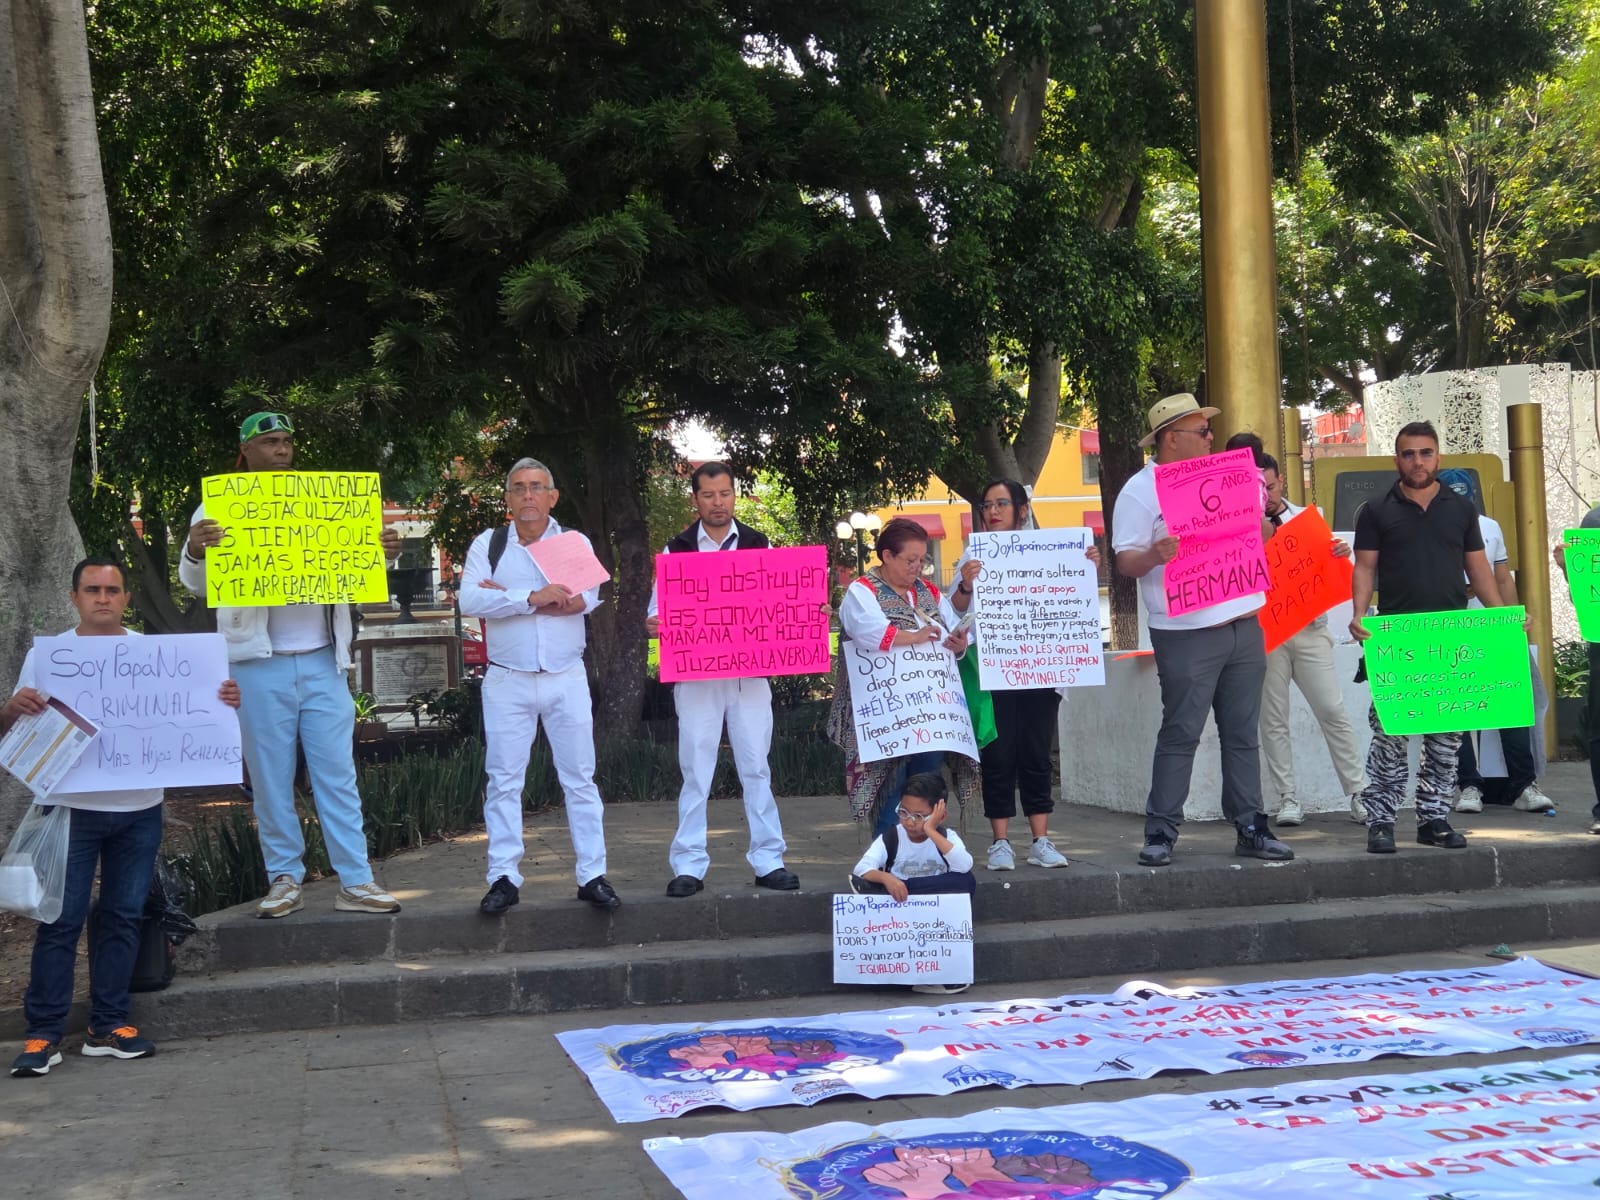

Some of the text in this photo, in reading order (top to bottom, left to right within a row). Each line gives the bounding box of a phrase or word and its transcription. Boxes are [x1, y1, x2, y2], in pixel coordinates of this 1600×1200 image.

[207, 474, 381, 498] CADA CONVIVENCIA
[1199, 479, 1221, 512] 6
[243, 526, 331, 548] TIEMPO
[336, 526, 377, 546] QUE
[215, 550, 382, 573] JAMÁS REGRESA
[976, 560, 1085, 584] Soy mamá soltera
[1213, 558, 1221, 566] a
[211, 571, 368, 602] Y TE ARREBATAN PARA
[664, 557, 825, 602] Hoy obstruyen
[1166, 557, 1271, 613] HERMANA
[286, 592, 356, 605] SIEMPRE
[977, 585, 1004, 599] pero
[1007, 586, 1027, 594] aun
[1048, 586, 1077, 598] apoyo
[663, 600, 828, 628] las convivencias
[976, 611, 1013, 620] conozco
[1017, 609, 1027, 620] la
[981, 599, 1011, 612] porque
[1025, 596, 1041, 612] hijo
[1086, 599, 1092, 608] y
[660, 624, 822, 647] MAÑANA MI HIJO
[979, 619, 1099, 634] papás que huyen y papás
[982, 632, 998, 644] que
[1072, 628, 1099, 640] estos
[778, 644, 829, 667] VERDAD
[856, 648, 897, 676] Soy
[903, 641, 945, 661] abuela
[1019, 644, 1034, 655] NO
[1035, 644, 1052, 654] LES
[1055, 643, 1089, 654] QUITEN
[1377, 645, 1415, 662] Mis
[50, 648, 107, 690] Soy
[983, 659, 996, 667] SU
[1033, 658, 1047, 668] NO
[1047, 656, 1064, 666] LES
[1066, 656, 1099, 666] LLAMEN
[866, 674, 897, 699] digo
[901, 670, 925, 683] con
[1376, 670, 1476, 686] NO necesitan
[1458, 680, 1522, 694] necesitan
[75, 690, 211, 720] CRIMINAL
[888, 694, 904, 713] ES
[936, 691, 952, 705] NO
[857, 721, 891, 742] Tiene
[891, 708, 937, 732] derecho
[939, 712, 947, 720] a
[875, 739, 899, 757] hijo
[902, 737, 910, 750] y
[911, 728, 931, 746] YO
[933, 731, 943, 740] a
[945, 729, 956, 739] mi
[836, 916, 945, 935] Los derechos son de
[836, 936, 868, 946] TODAS
[871, 936, 878, 946] Y
[840, 946, 952, 962] es avanzar hacia la
[856, 961, 942, 975] IGUALDAD REAL
